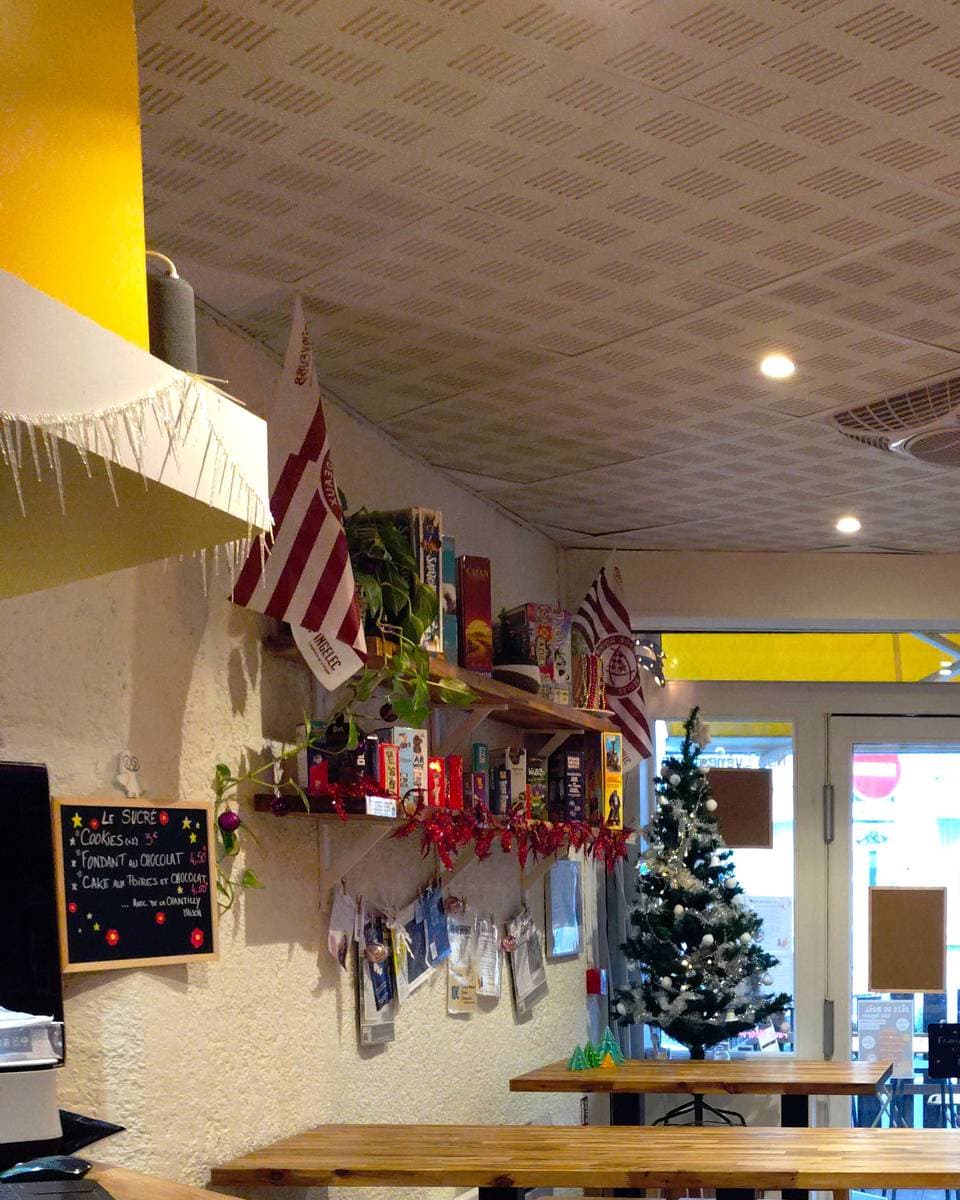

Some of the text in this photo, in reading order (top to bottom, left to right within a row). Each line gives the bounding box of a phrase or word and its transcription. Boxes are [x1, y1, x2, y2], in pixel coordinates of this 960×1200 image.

[101, 808, 158, 825] LE SUCRÉ
[80, 828, 124, 847] COOKIES
[82, 850, 127, 869] FONDANT
[128, 858, 138, 868] AU
[140, 852, 184, 868] CHOCOLAT
[82, 875, 110, 889] CAKE
[126, 874, 158, 887] POIRES
[170, 872, 207, 884] CHOCOLAT
